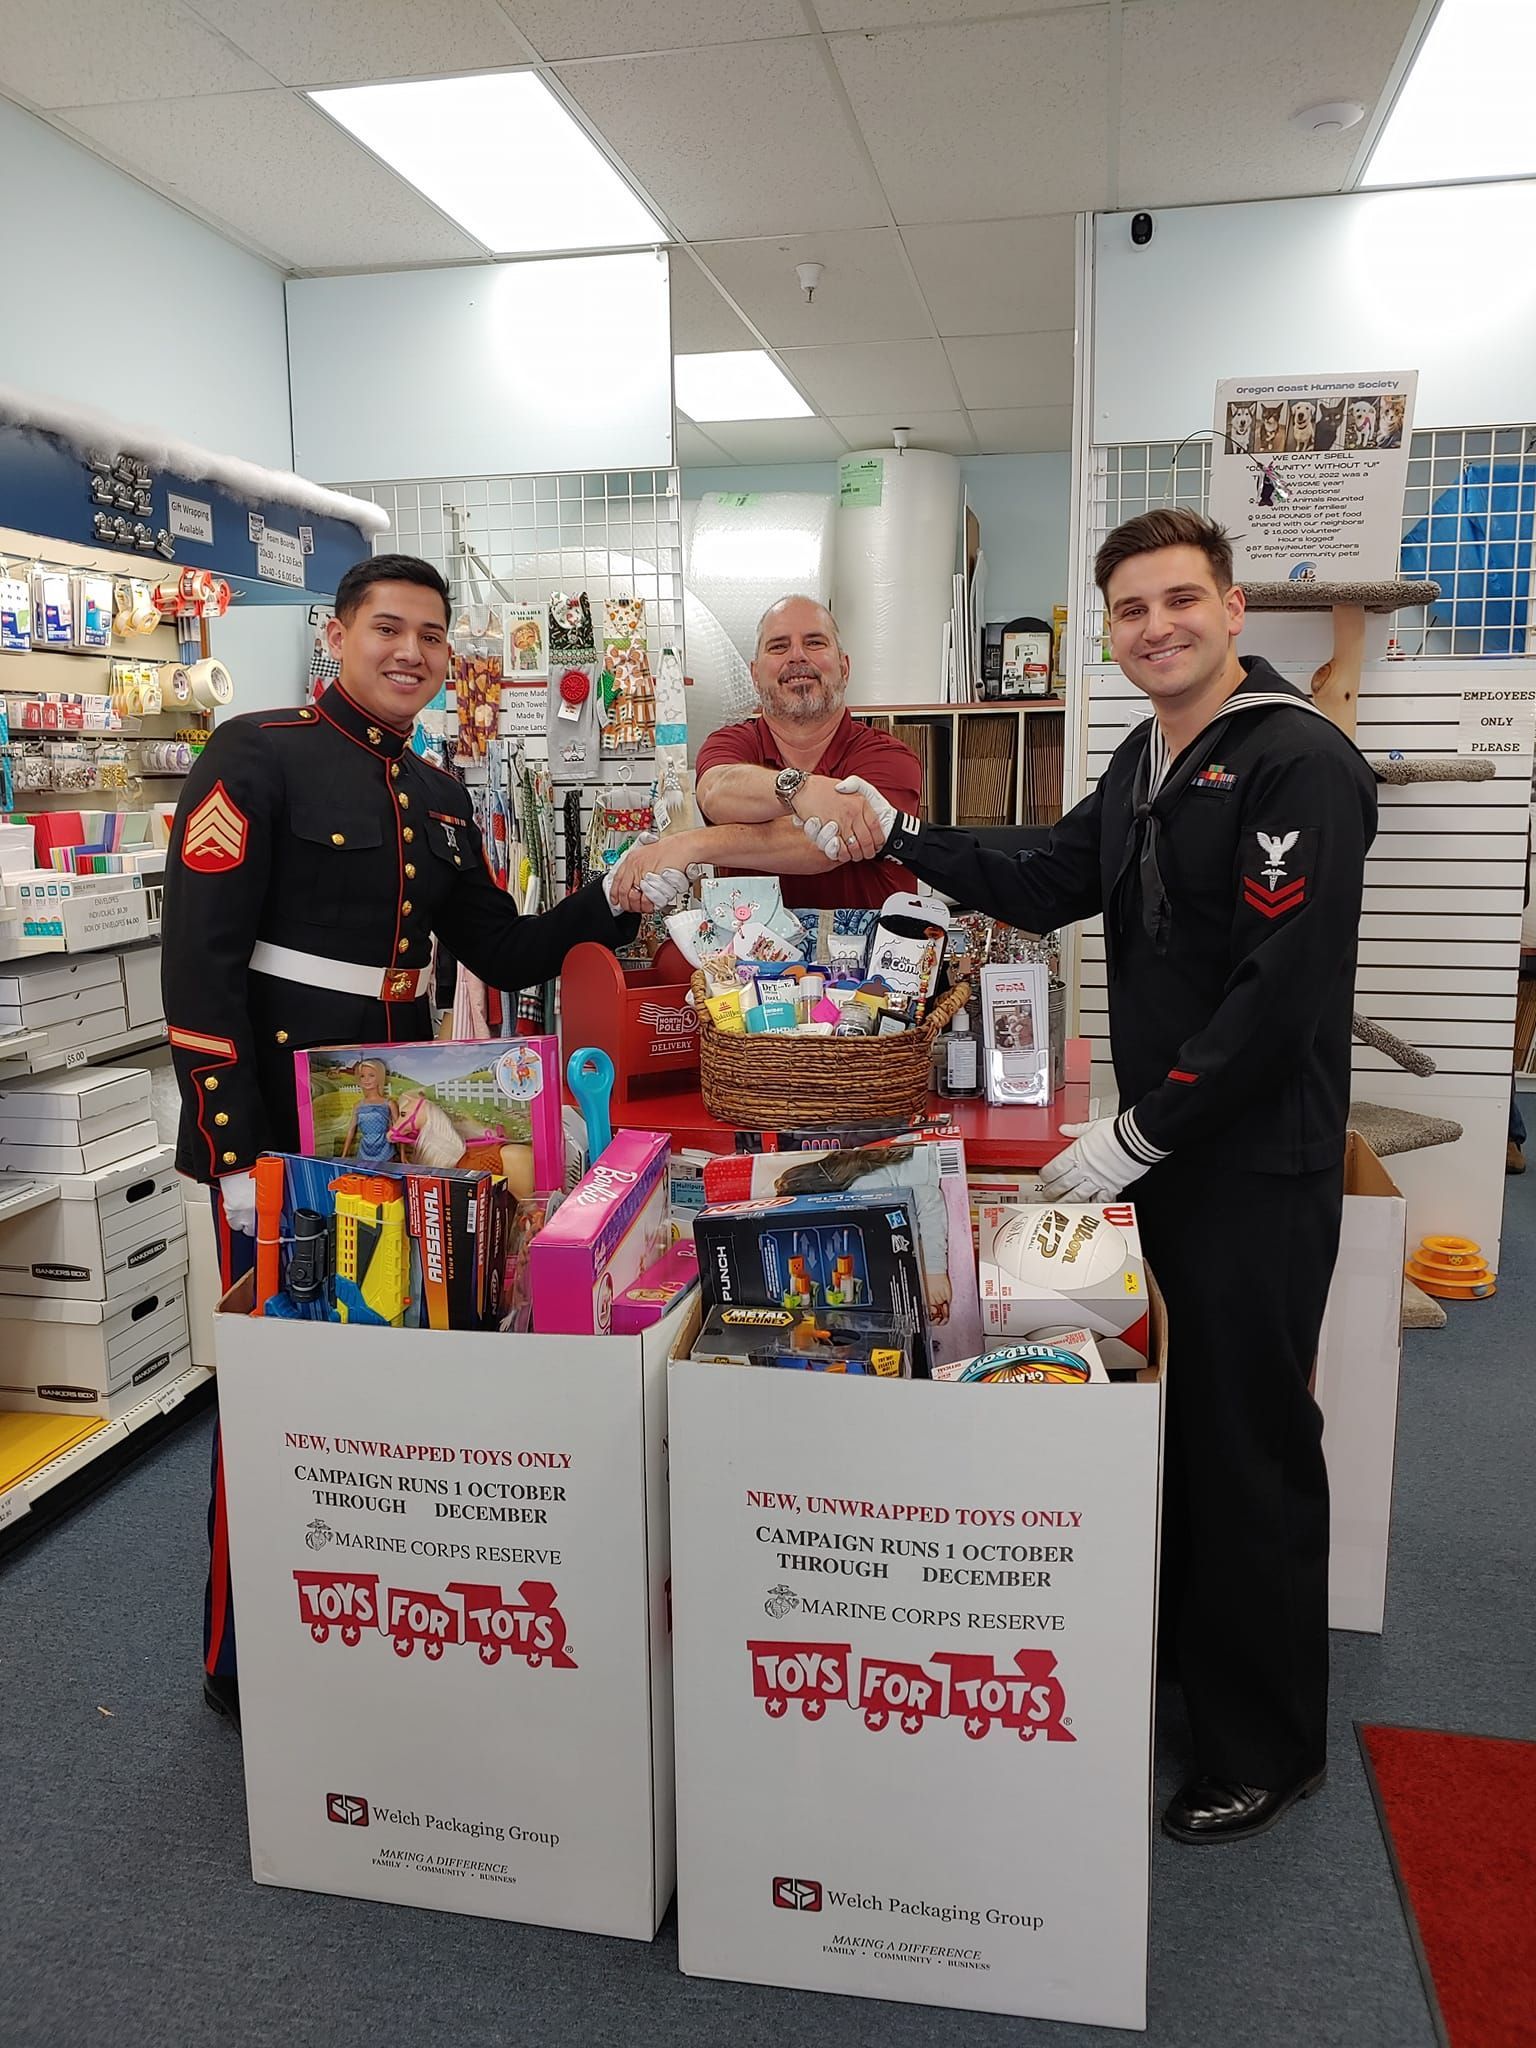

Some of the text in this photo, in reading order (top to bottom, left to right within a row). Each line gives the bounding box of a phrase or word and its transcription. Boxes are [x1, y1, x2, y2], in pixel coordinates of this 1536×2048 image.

[1236, 380, 1399, 395] Oregon Coast Humane Society
[1315, 462, 1360, 470] WITHOUT
[171, 500, 210, 522] Gift Wrapping
[1325, 511, 1339, 519] pet
[179, 522, 205, 537] Available
[1320, 519, 1365, 527] neighbors!
[266, 532, 279, 545] Foam
[1264, 544, 1317, 552] Spay/Neuter
[1250, 552, 1272, 560] given
[1290, 550, 1336, 558] community
[1338, 550, 1360, 558] pets!
[509, 690, 529, 698] Home
[511, 701, 525, 709] Dish
[1463, 691, 1536, 701] EMPLOYEES
[536, 712, 544, 720] By
[1480, 717, 1514, 727] ONLY
[510, 724, 529, 732] Diane
[1471, 743, 1520, 752] PLEASE
[659, 1024, 681, 1032] POLE
[67, 1050, 85, 1065] $5.00
[651, 1040, 693, 1053] DELIVERY
[577, 1165, 638, 1207] Barbie
[444, 1207, 452, 1221] Set
[423, 1186, 443, 1284] ARSENAL
[446, 1223, 454, 1255] Blaster
[1037, 1209, 1070, 1259] AVP
[1062, 1214, 1100, 1265] Wilson
[130, 1243, 165, 1265] BANKERS BOX
[35, 1267, 87, 1278] BANKERS BOX
[716, 1245, 732, 1302] PUNCH
[728, 1316, 785, 1325] MACHINES
[730, 1310, 787, 1319] METAL
[134, 1356, 168, 1382] BANKERS BOX
[968, 1344, 1057, 1375] Wilson
[41, 1388, 95, 1399] BANKERS BOX
[285, 1432, 573, 1469] NEW, UNWRAPPED TOYS ONLY
[294, 1464, 567, 1502] CAMPAIGN RUNS 1 OCTOBER
[312, 1489, 549, 1525] THROUGH DECEMBER
[746, 1490, 1083, 1528] NEW, UNWRAPPED TOYS ONLY
[335, 1531, 562, 1566] MARINE CORPS RESERVE
[755, 1525, 1075, 1564] CAMPAIGN RUNS 1 OCTOBER
[776, 1552, 1052, 1588] THROUGH DECEMBER
[302, 1582, 554, 1650] TOYS FOR TOTS
[801, 1598, 1066, 1631] MARINE CORPS RESERVE
[756, 1652, 1051, 1722] TOYS FOR TOTS
[372, 1806, 560, 1848] Welch Packaging Group
[371, 1857, 517, 1884] FAMILY COMMUNITY BUSINESS
[379, 1848, 509, 1875] MAKING A DIFFERENCE
[827, 1889, 1044, 1931] Welch Packaging Group
[822, 1944, 991, 1970] FAMILY COMMUNITY BUSINESS
[832, 1935, 982, 1960] MAKING A DIFFERENCE
